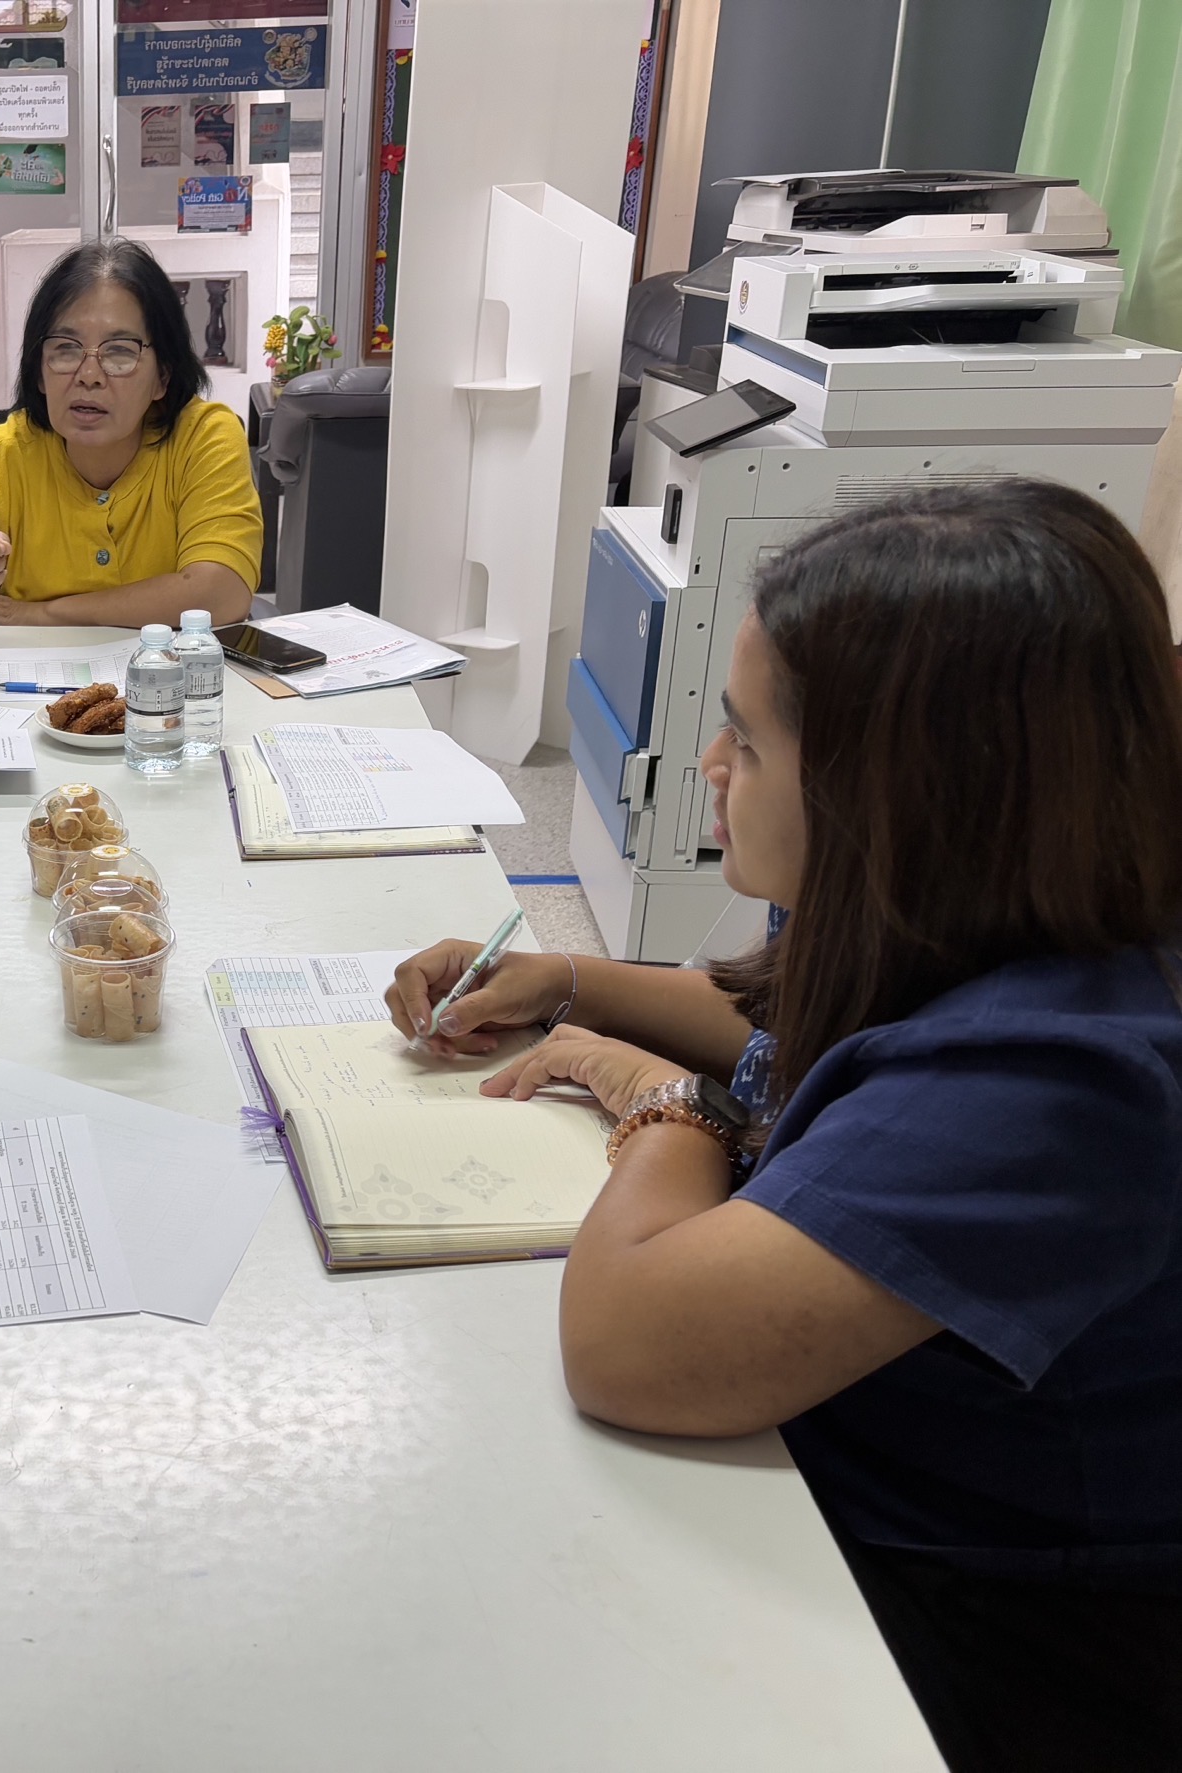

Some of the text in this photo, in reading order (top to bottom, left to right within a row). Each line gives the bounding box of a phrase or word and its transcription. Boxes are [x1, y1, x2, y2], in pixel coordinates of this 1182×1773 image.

[35, 81, 60, 93] ถอดปลั๊ก
[18, 107, 38, 120] ทุกครั้ง
